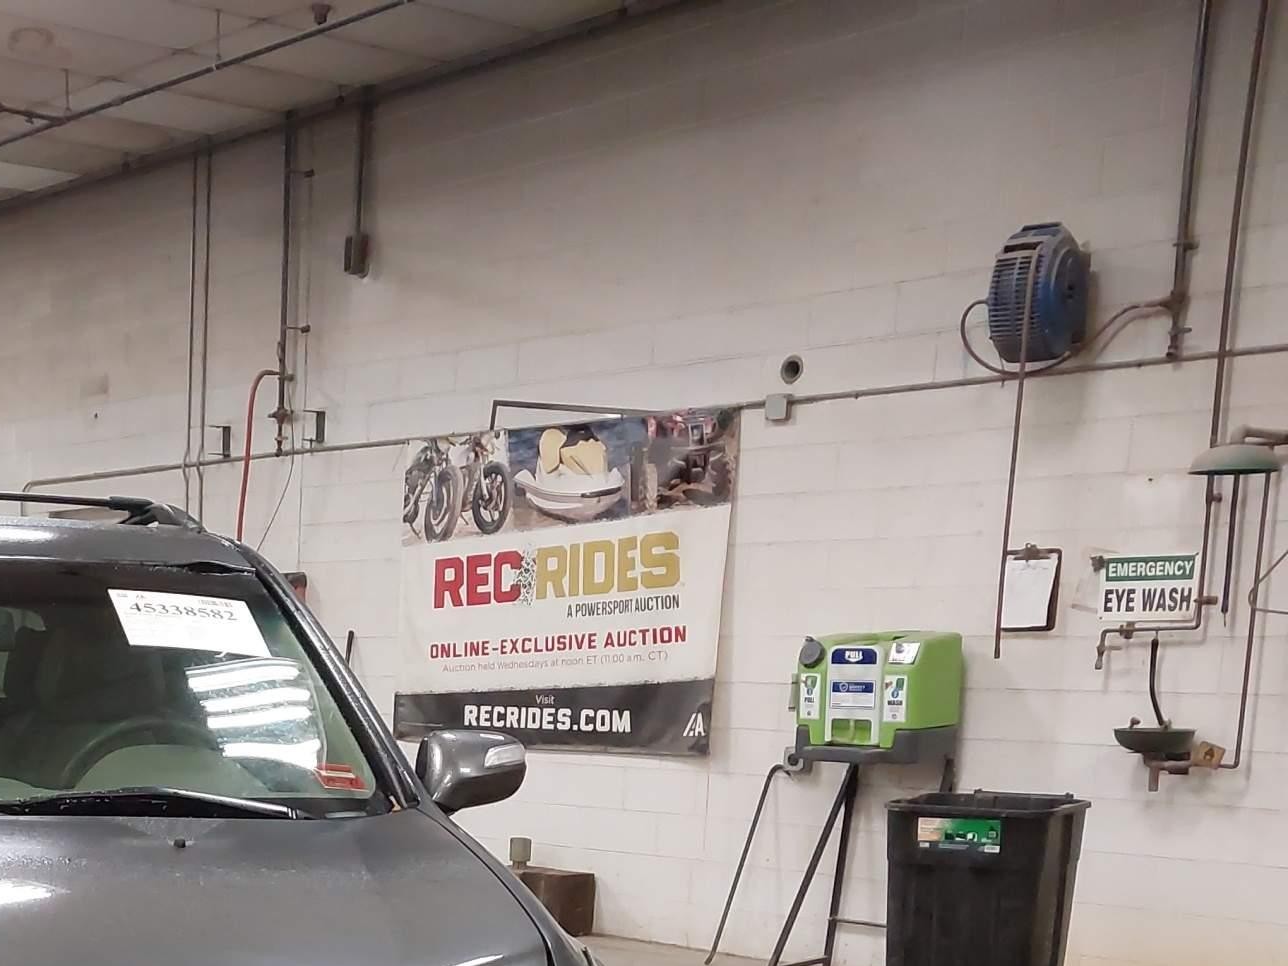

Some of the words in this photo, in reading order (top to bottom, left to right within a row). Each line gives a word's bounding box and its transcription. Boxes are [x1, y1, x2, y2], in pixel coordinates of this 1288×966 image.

[433, 551, 523, 609] REC
[536, 531, 681, 600] RIDES
[1108, 560, 1193, 577] EMERGENCY
[129, 602, 237, 621] 45338582
[567, 604, 573, 618] A
[575, 599, 632, 617] POWERSPORT
[634, 594, 680, 613] AUCTION
[1103, 587, 1136, 613] EYE
[1142, 586, 1192, 613] WASH
[430, 632, 598, 659] ONLINE-EXCLUSIVE
[603, 625, 687, 649] AUCTION
[442, 662, 476, 673] Auction
[477, 660, 496, 671] held
[497, 658, 549, 670] Wednesdays
[550, 657, 559, 667] at
[561, 655, 584, 666] noon
[586, 655, 597, 665] ET
[648, 650, 669, 662] CT)
[535, 694, 555, 705] Visit
[463, 704, 632, 733] RECRIDES.COM
